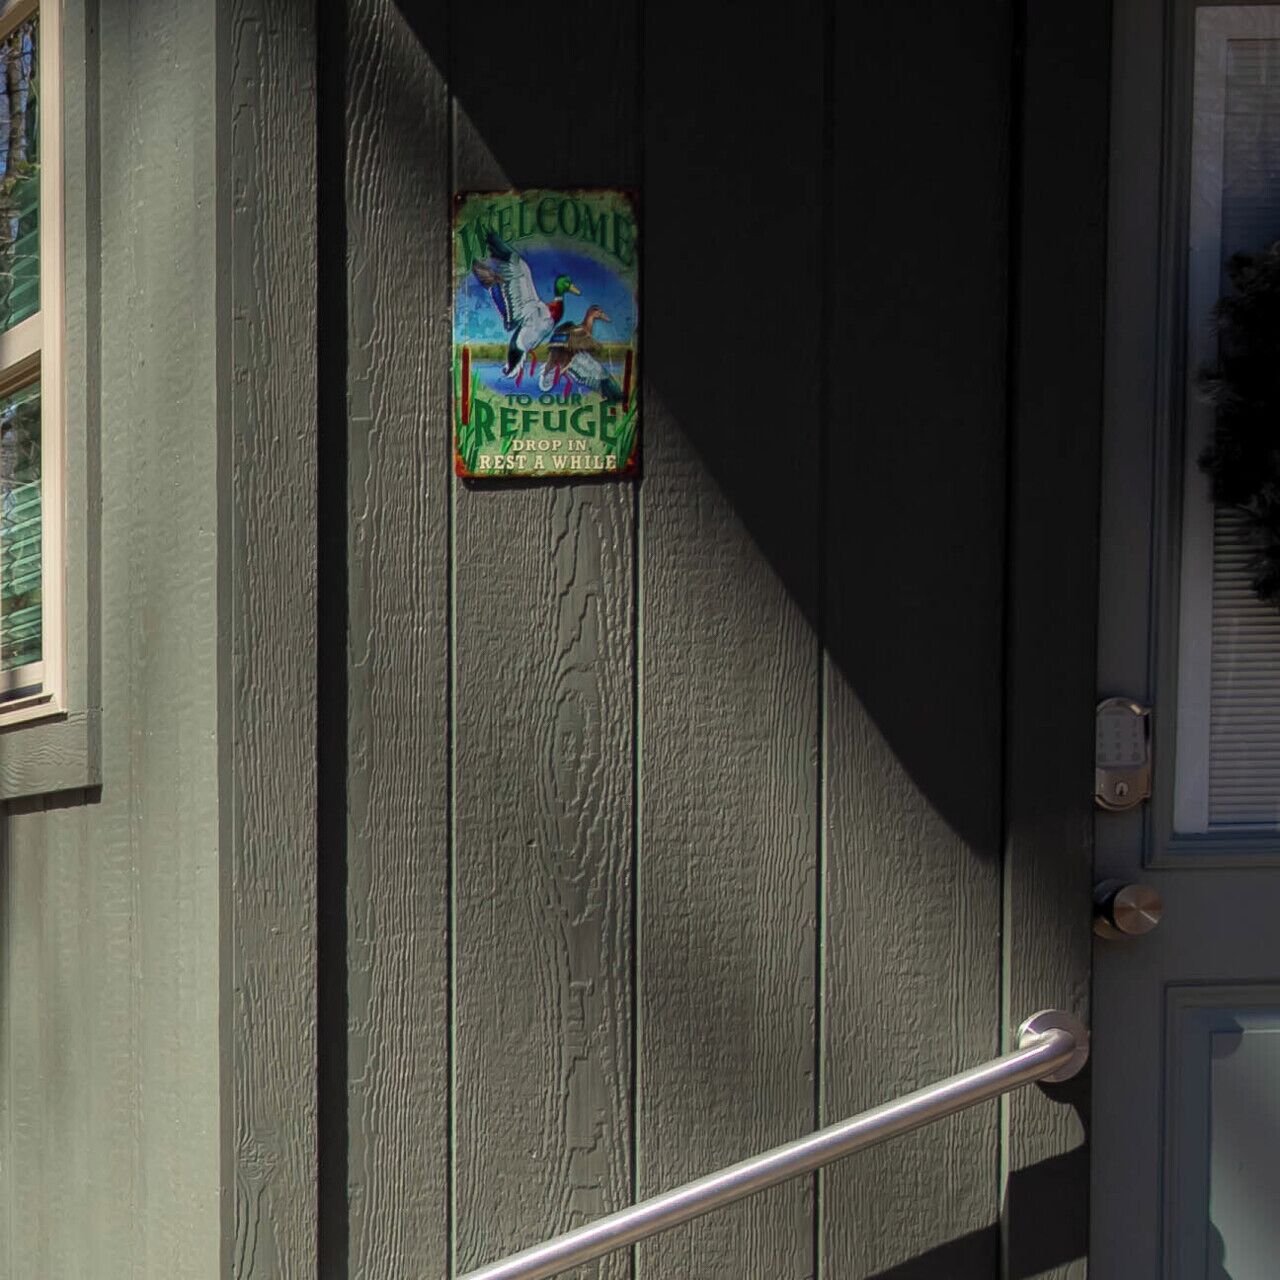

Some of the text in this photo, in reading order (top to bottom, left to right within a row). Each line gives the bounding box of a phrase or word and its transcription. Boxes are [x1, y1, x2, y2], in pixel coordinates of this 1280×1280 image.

[458, 197, 637, 271] WELCOME
[505, 393, 582, 406] TO OUR
[474, 397, 619, 447] REFUGE
[512, 439, 587, 452] DROP IN
[479, 455, 617, 470] REST A WHILE
